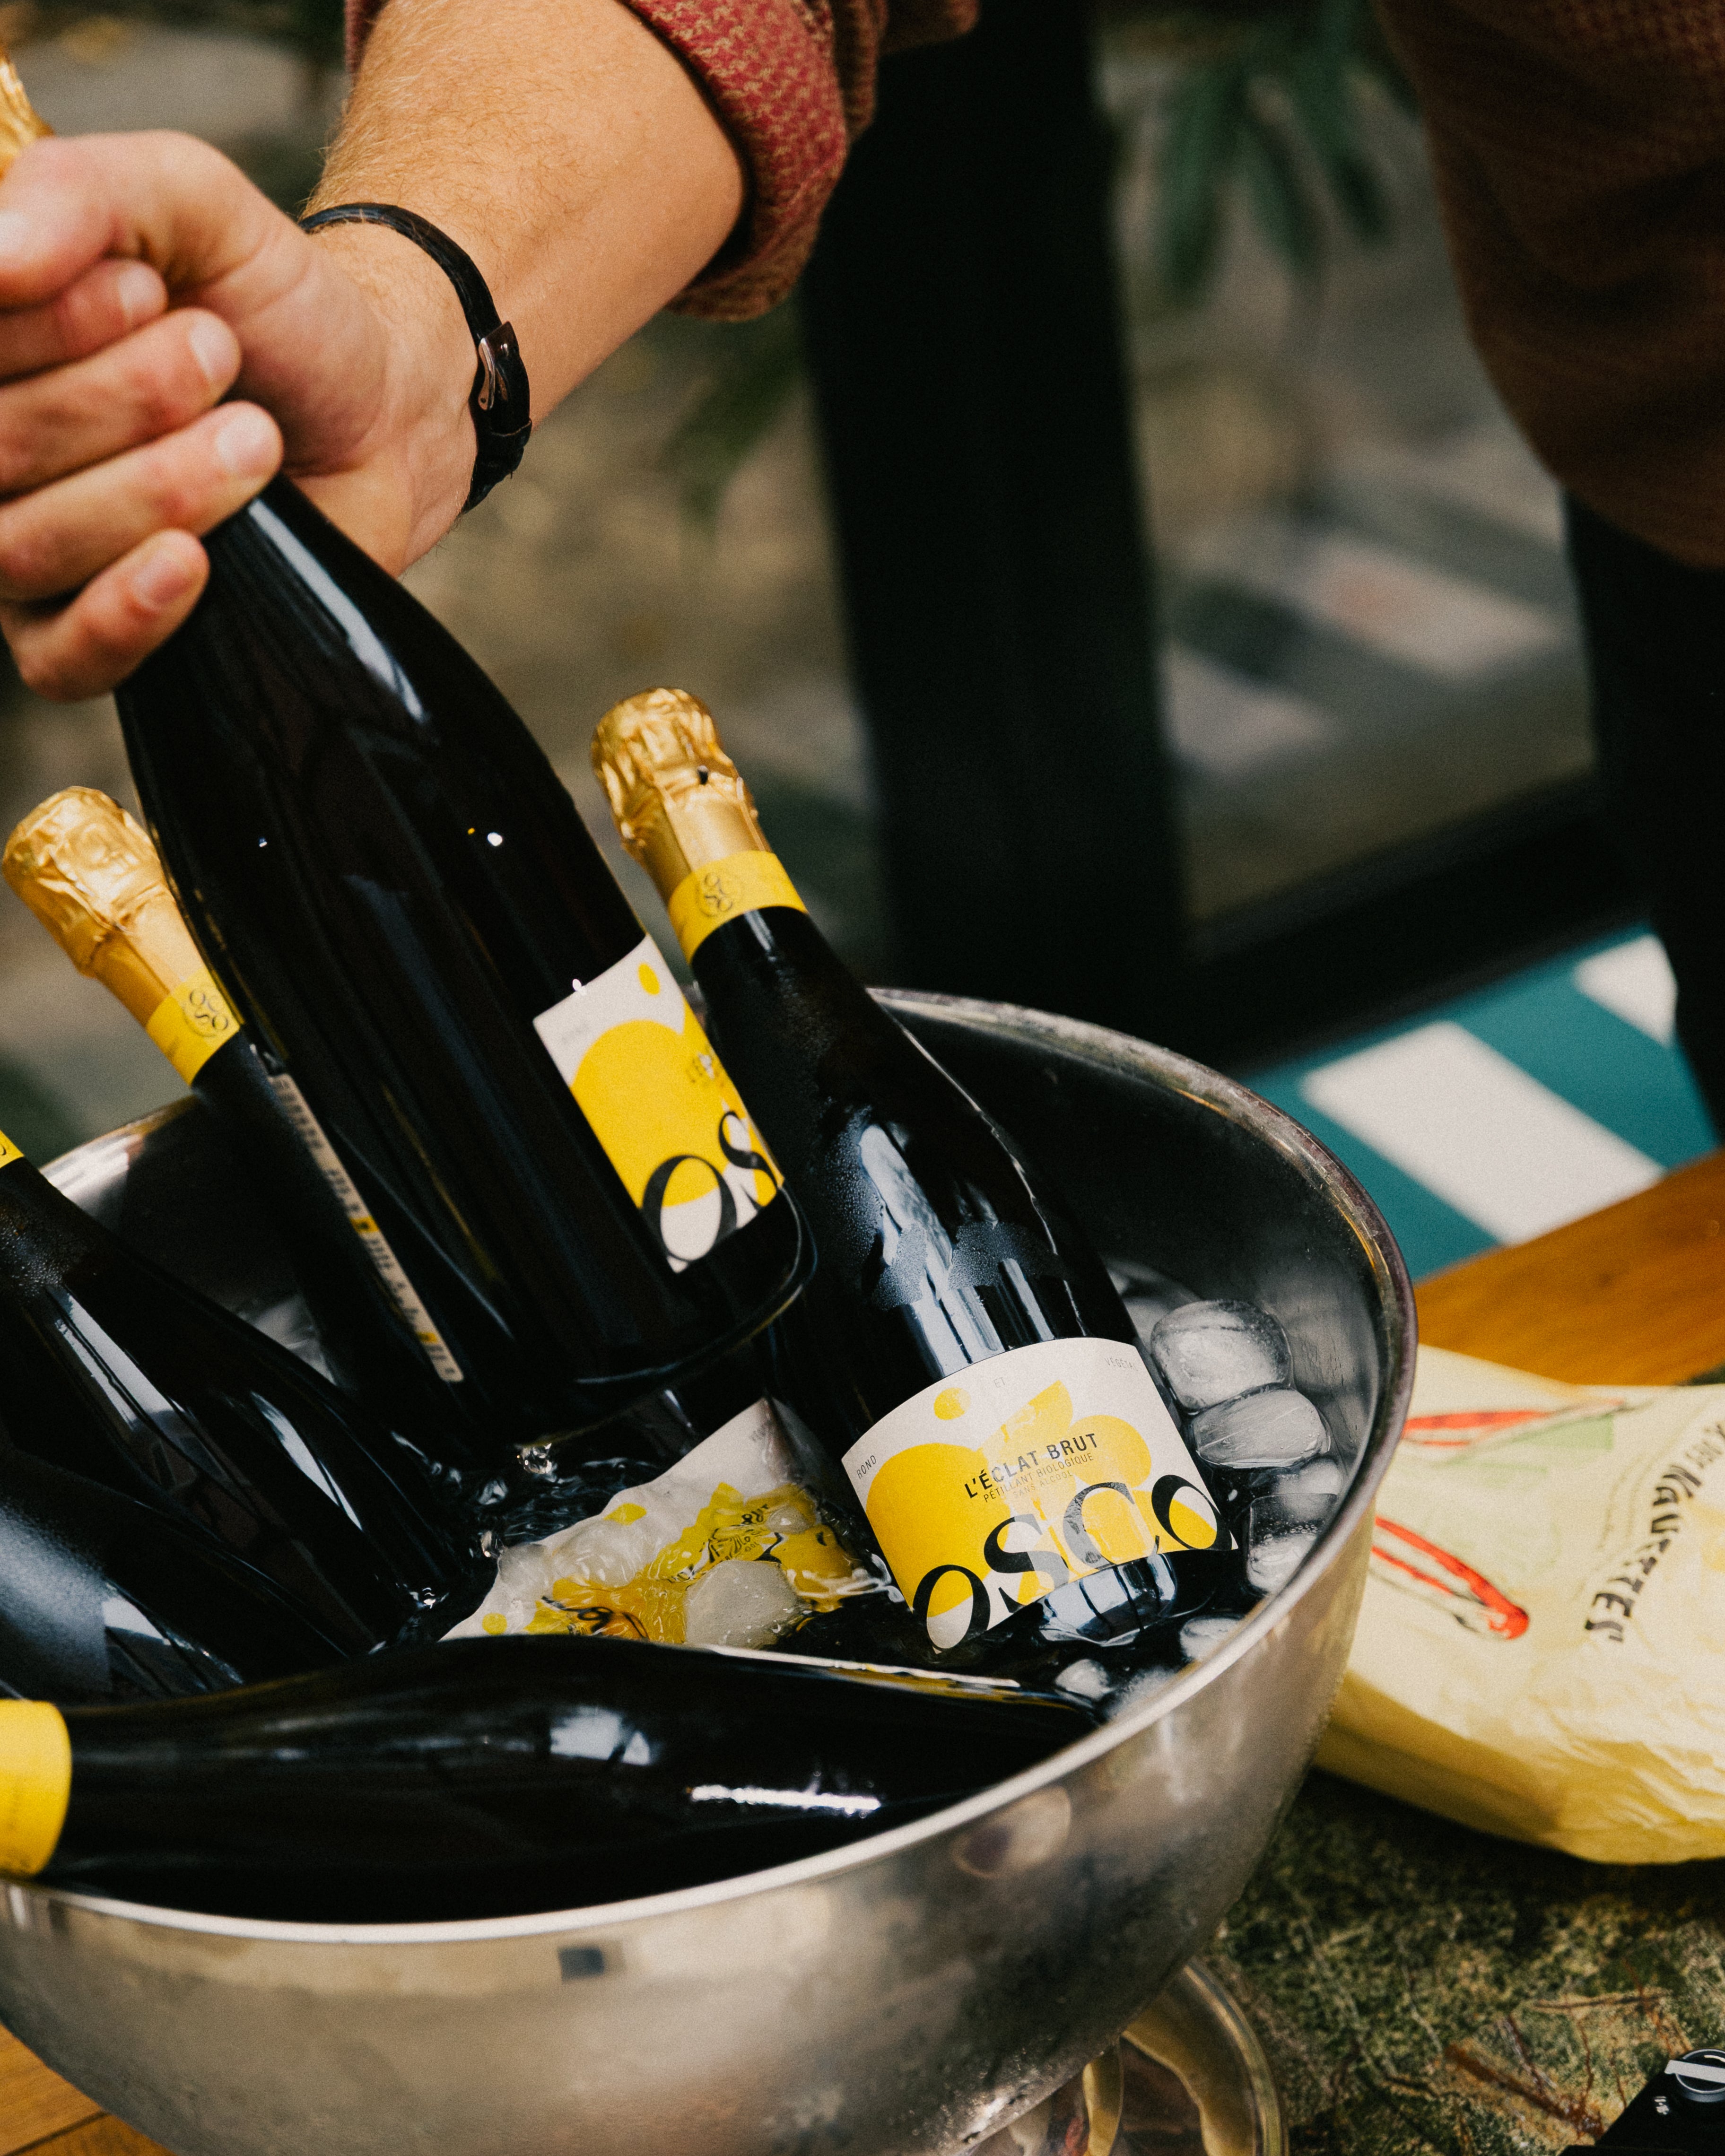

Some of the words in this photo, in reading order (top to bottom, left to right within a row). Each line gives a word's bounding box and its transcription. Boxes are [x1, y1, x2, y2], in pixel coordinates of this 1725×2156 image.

[993, 1377, 1005, 1388] ET
[856, 1455, 877, 1479] ROND
[964, 1450, 1039, 1498] L'ÉCLAT
[1046, 1433, 1098, 1460] BRUT
[984, 1472, 1033, 1503] PÉTILLANT
[1037, 1452, 1094, 1478] BIOLOGIQUE
[1013, 1485, 1036, 1498] SANS
[1040, 1470, 1074, 1486] ALCOOL
[913, 1474, 1233, 1651] OSCO
